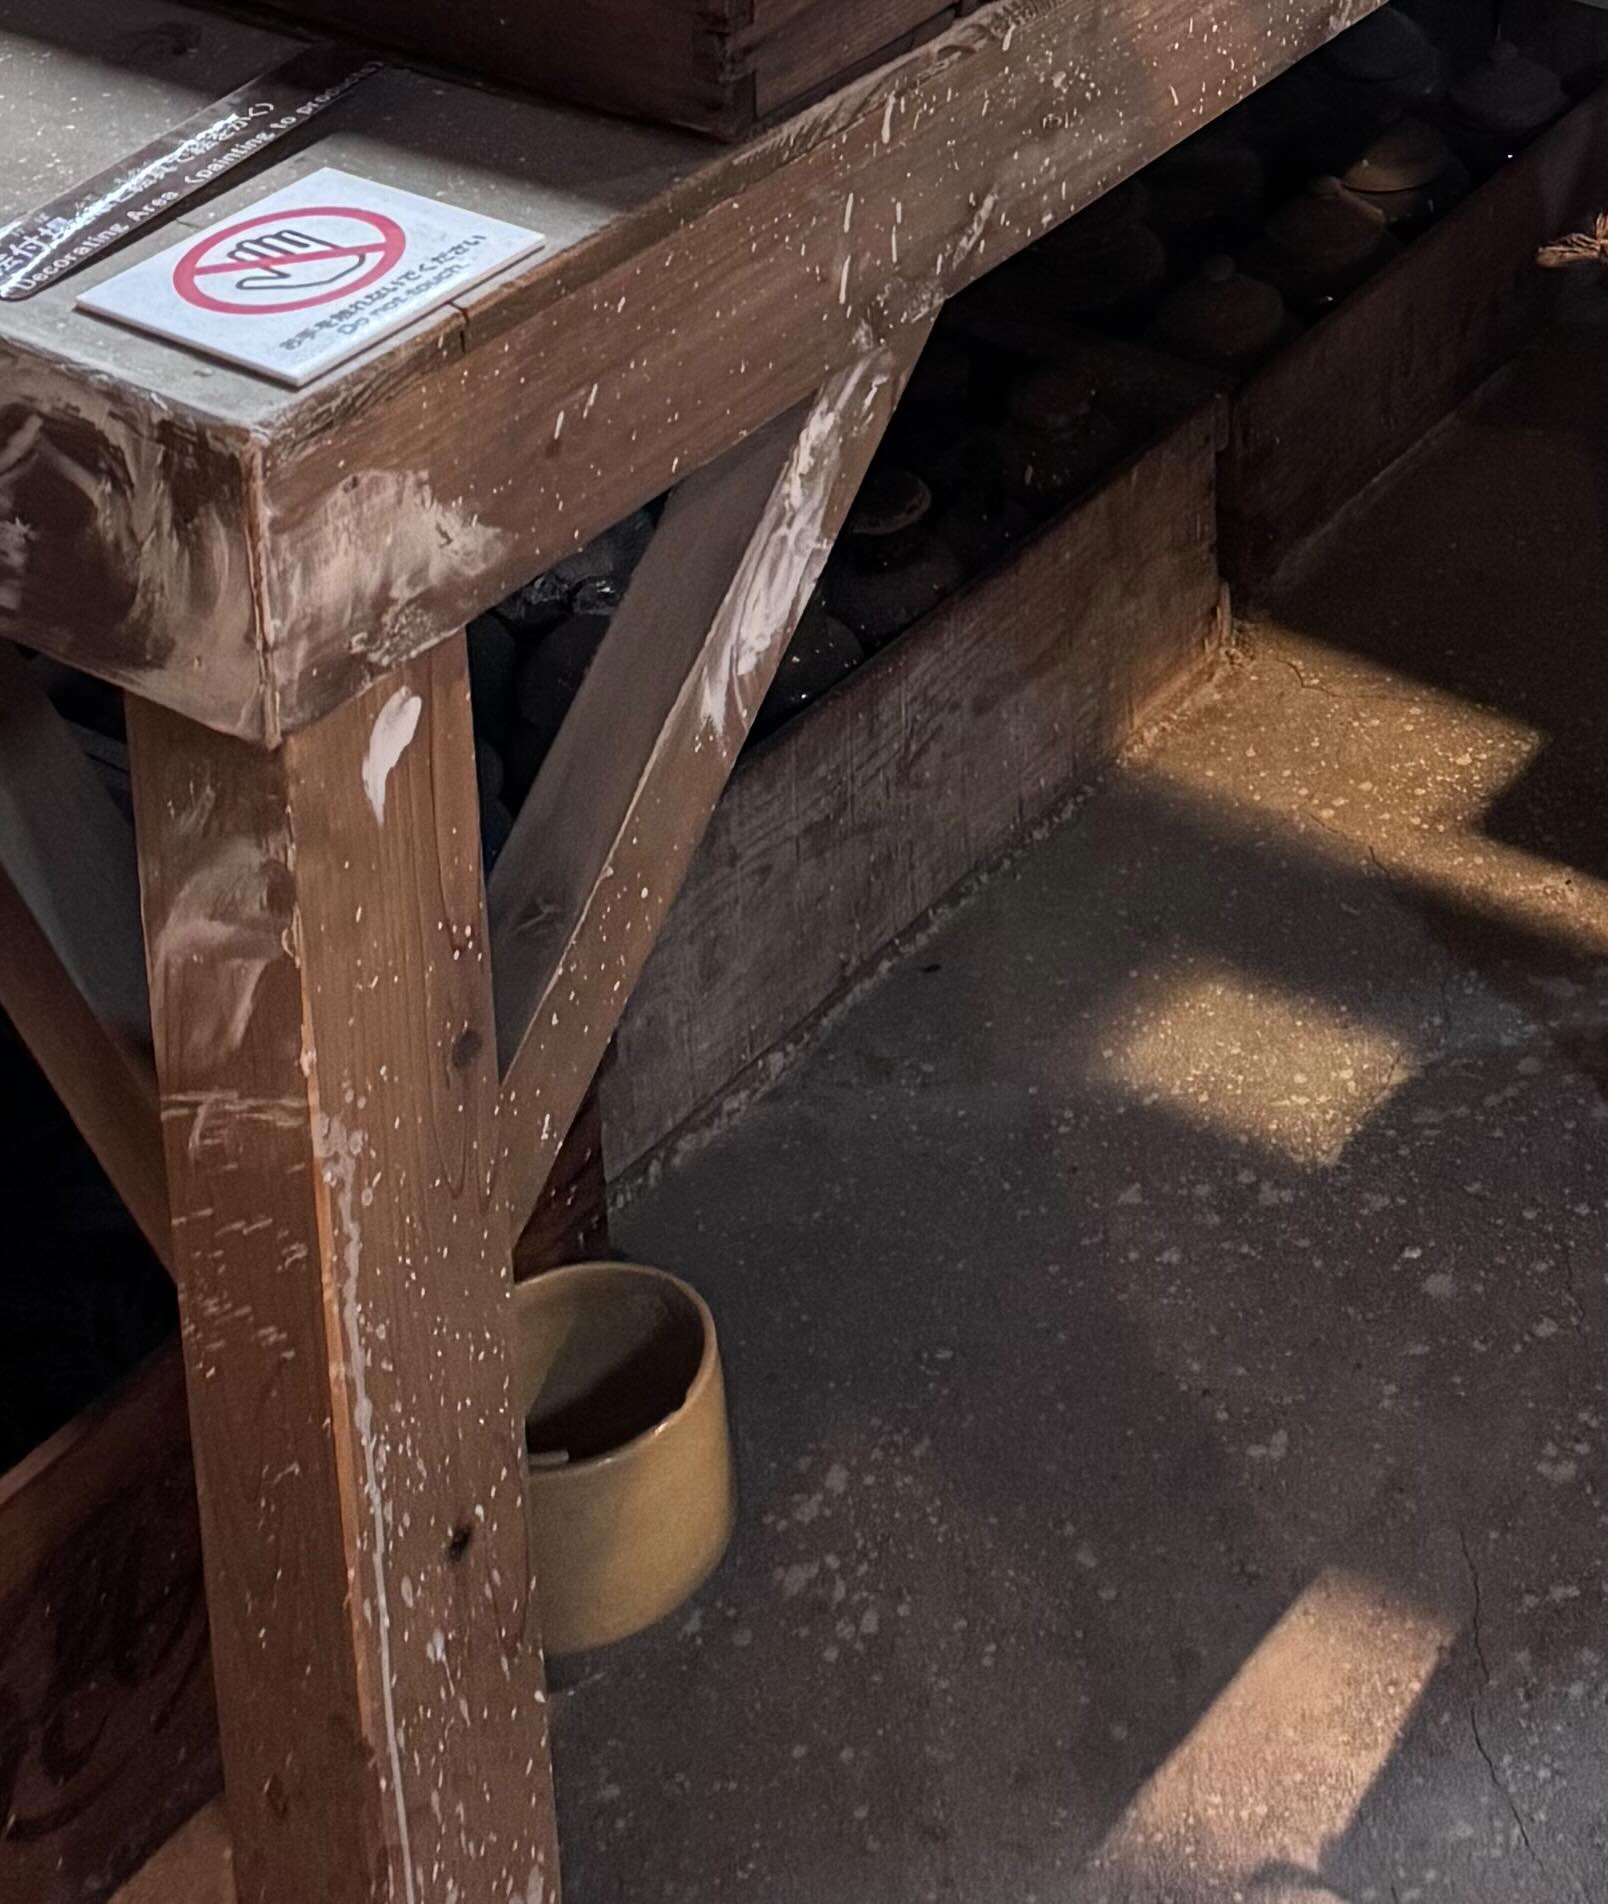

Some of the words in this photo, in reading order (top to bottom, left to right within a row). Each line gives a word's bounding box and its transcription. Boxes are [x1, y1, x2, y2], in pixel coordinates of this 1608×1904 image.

[16, 223, 130, 290] Decorating
[127, 192, 179, 222] Area
[184, 132, 275, 183] (painting
[269, 114, 298, 130] to
[337, 314, 370, 336] Do
[370, 295, 407, 317] not
